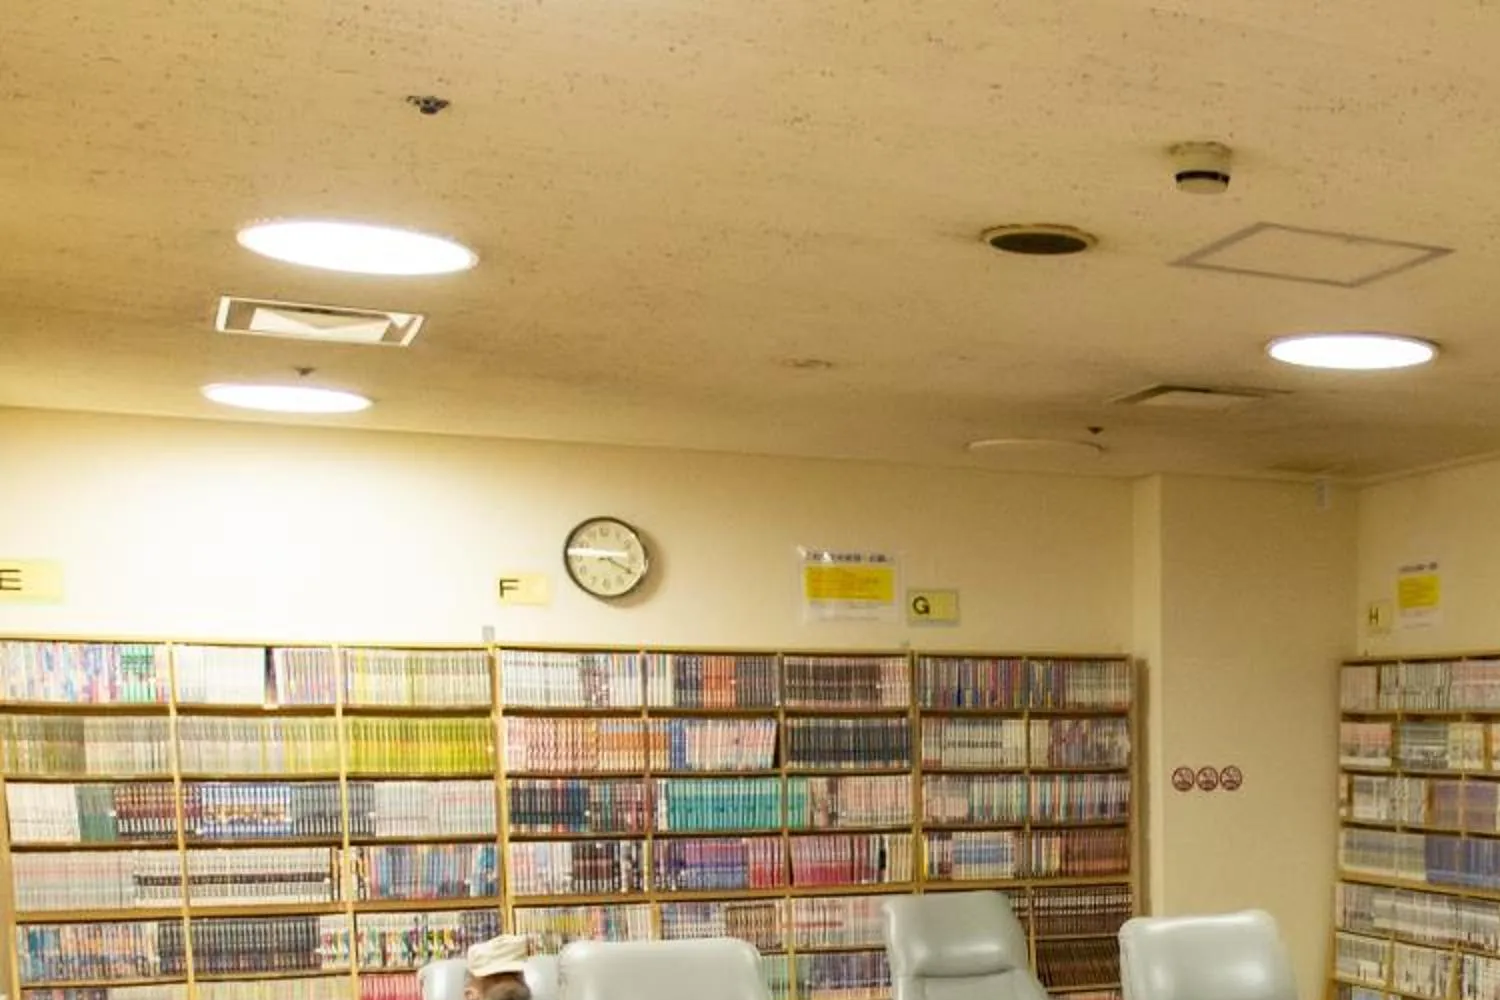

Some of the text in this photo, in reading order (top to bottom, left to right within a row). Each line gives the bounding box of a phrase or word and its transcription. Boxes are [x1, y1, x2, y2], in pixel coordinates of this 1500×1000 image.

[0, 569, 22, 591] E
[499, 578, 519, 598] F
[911, 596, 930, 615] G
[1369, 606, 1379, 626] H
